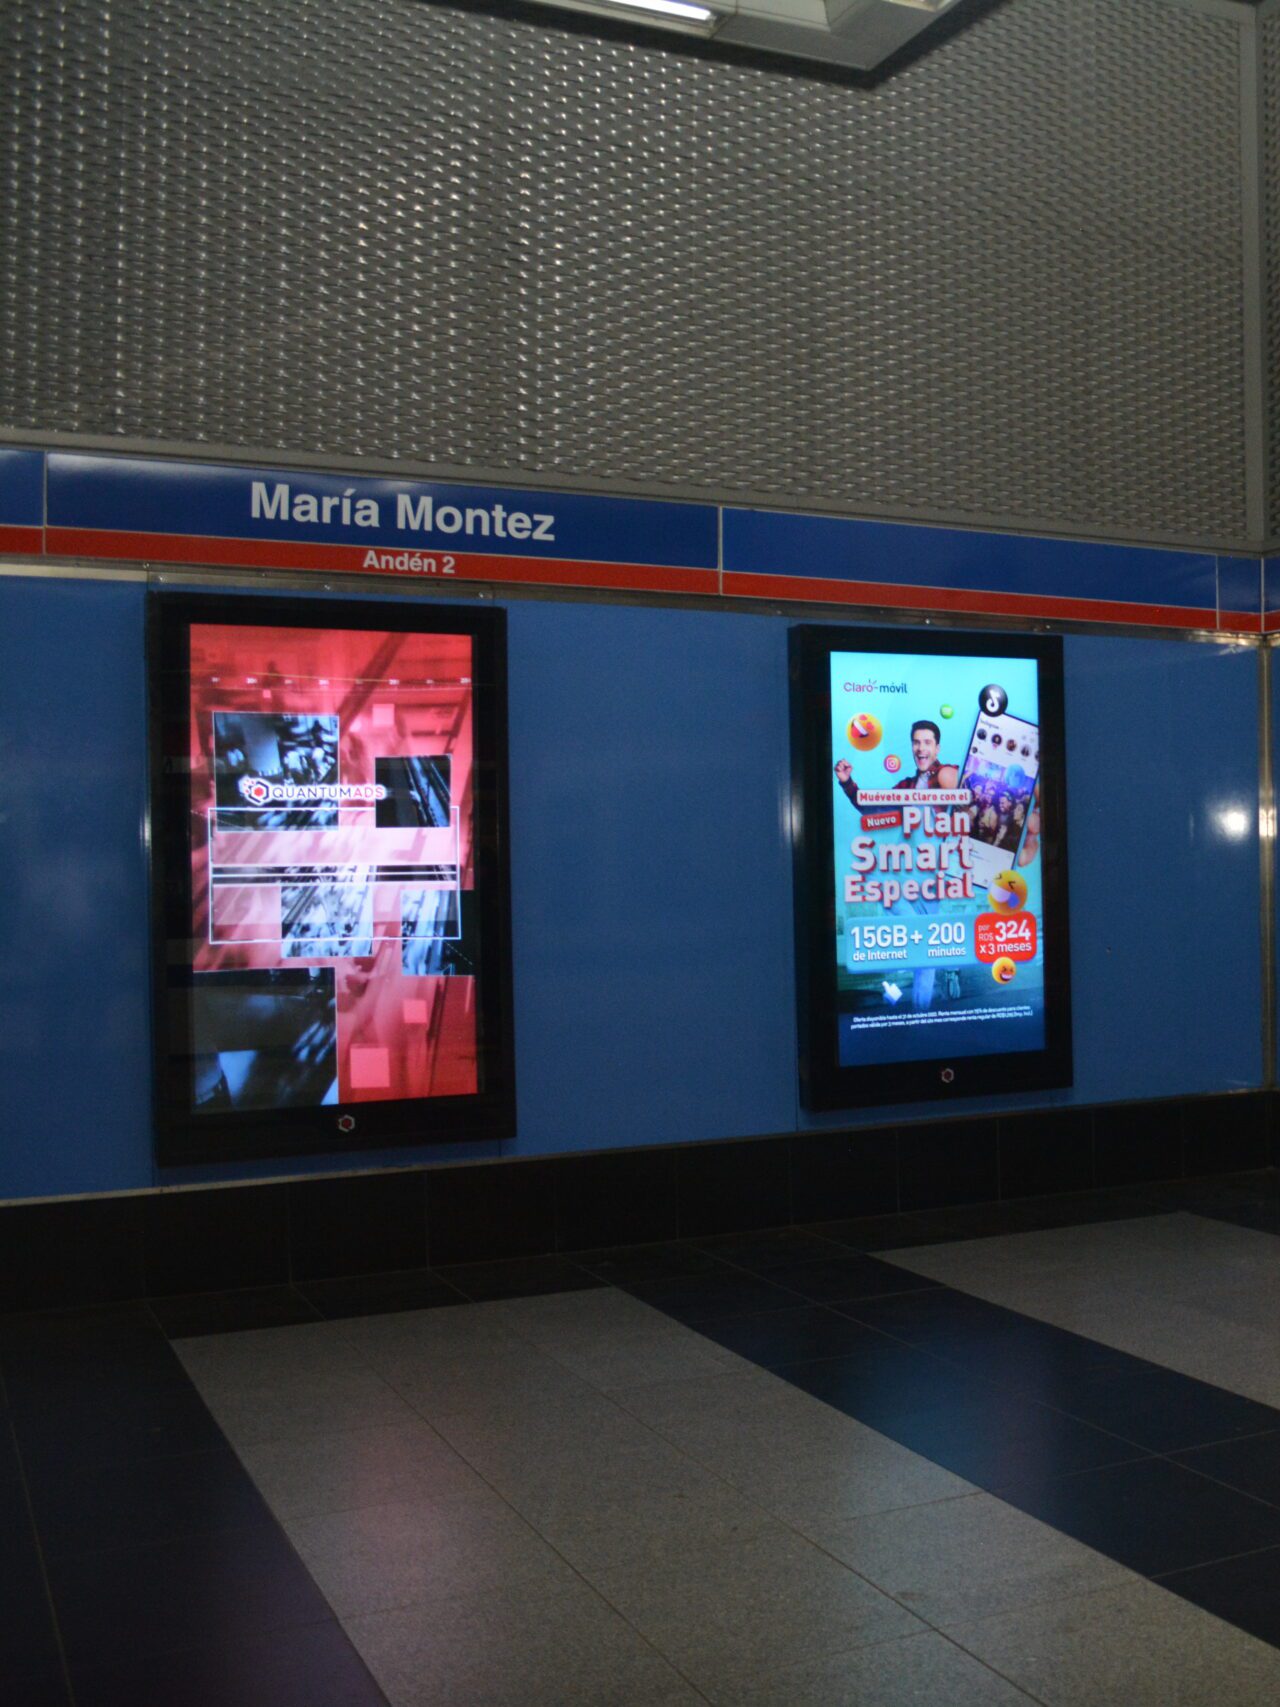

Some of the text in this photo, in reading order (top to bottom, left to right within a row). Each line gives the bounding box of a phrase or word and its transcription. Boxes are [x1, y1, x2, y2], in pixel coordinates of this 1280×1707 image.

[251, 482, 555, 541] María Montez
[363, 550, 455, 573] Andén 2
[843, 681, 907, 694] Claro móvil
[272, 785, 384, 800] QUANTUMADS
[860, 791, 901, 802] Muévete
[912, 791, 937, 801] Claro
[940, 793, 956, 801] con
[958, 791, 968, 801] el
[866, 807, 971, 836] Nuevo Plan
[851, 835, 973, 872] Smart
[844, 871, 975, 907] Especial
[851, 924, 907, 948] 15GB
[928, 922, 965, 945] 200
[978, 924, 990, 933] por
[995, 919, 1031, 942] 324
[853, 946, 966, 961] de Internet minutos
[980, 942, 1032, 955] x 3 meses
